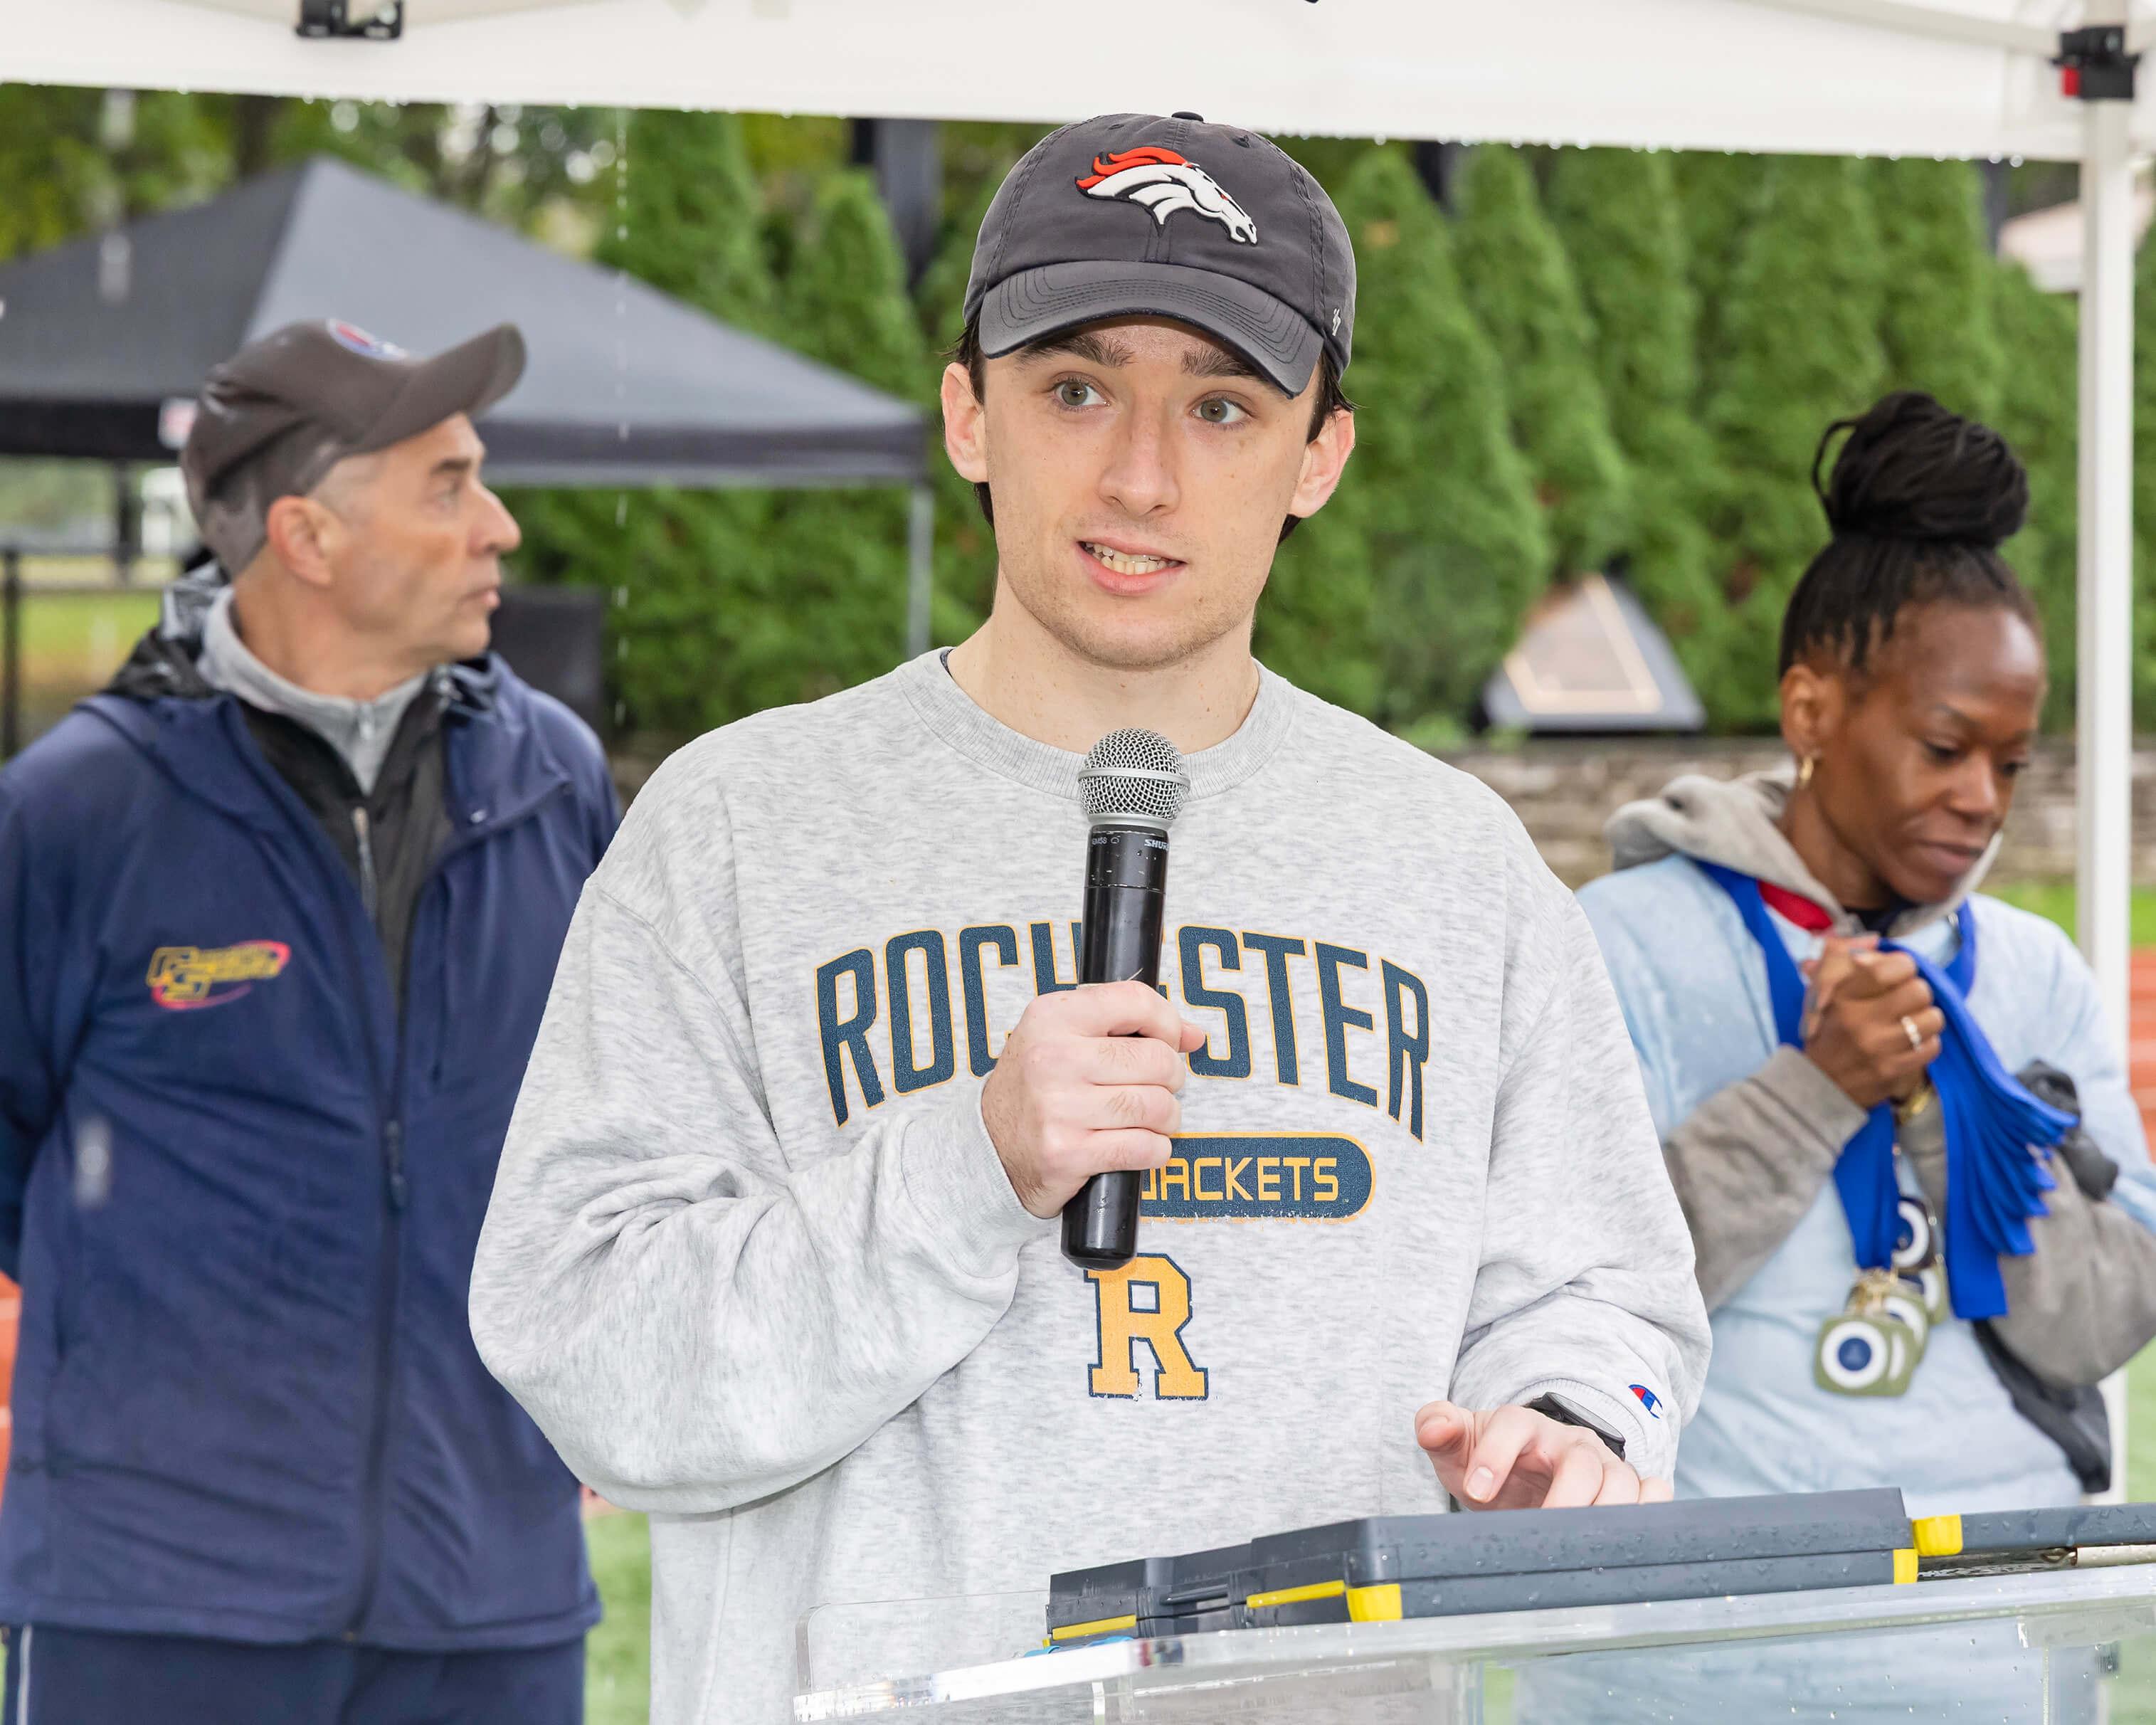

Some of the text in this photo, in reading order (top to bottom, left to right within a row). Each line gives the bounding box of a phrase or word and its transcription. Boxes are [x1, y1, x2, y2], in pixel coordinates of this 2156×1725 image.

[1144, 838, 1169, 851] SHUR
[815, 922, 1430, 1144] ROCSTER
[1084, 1252, 1210, 1401] R
